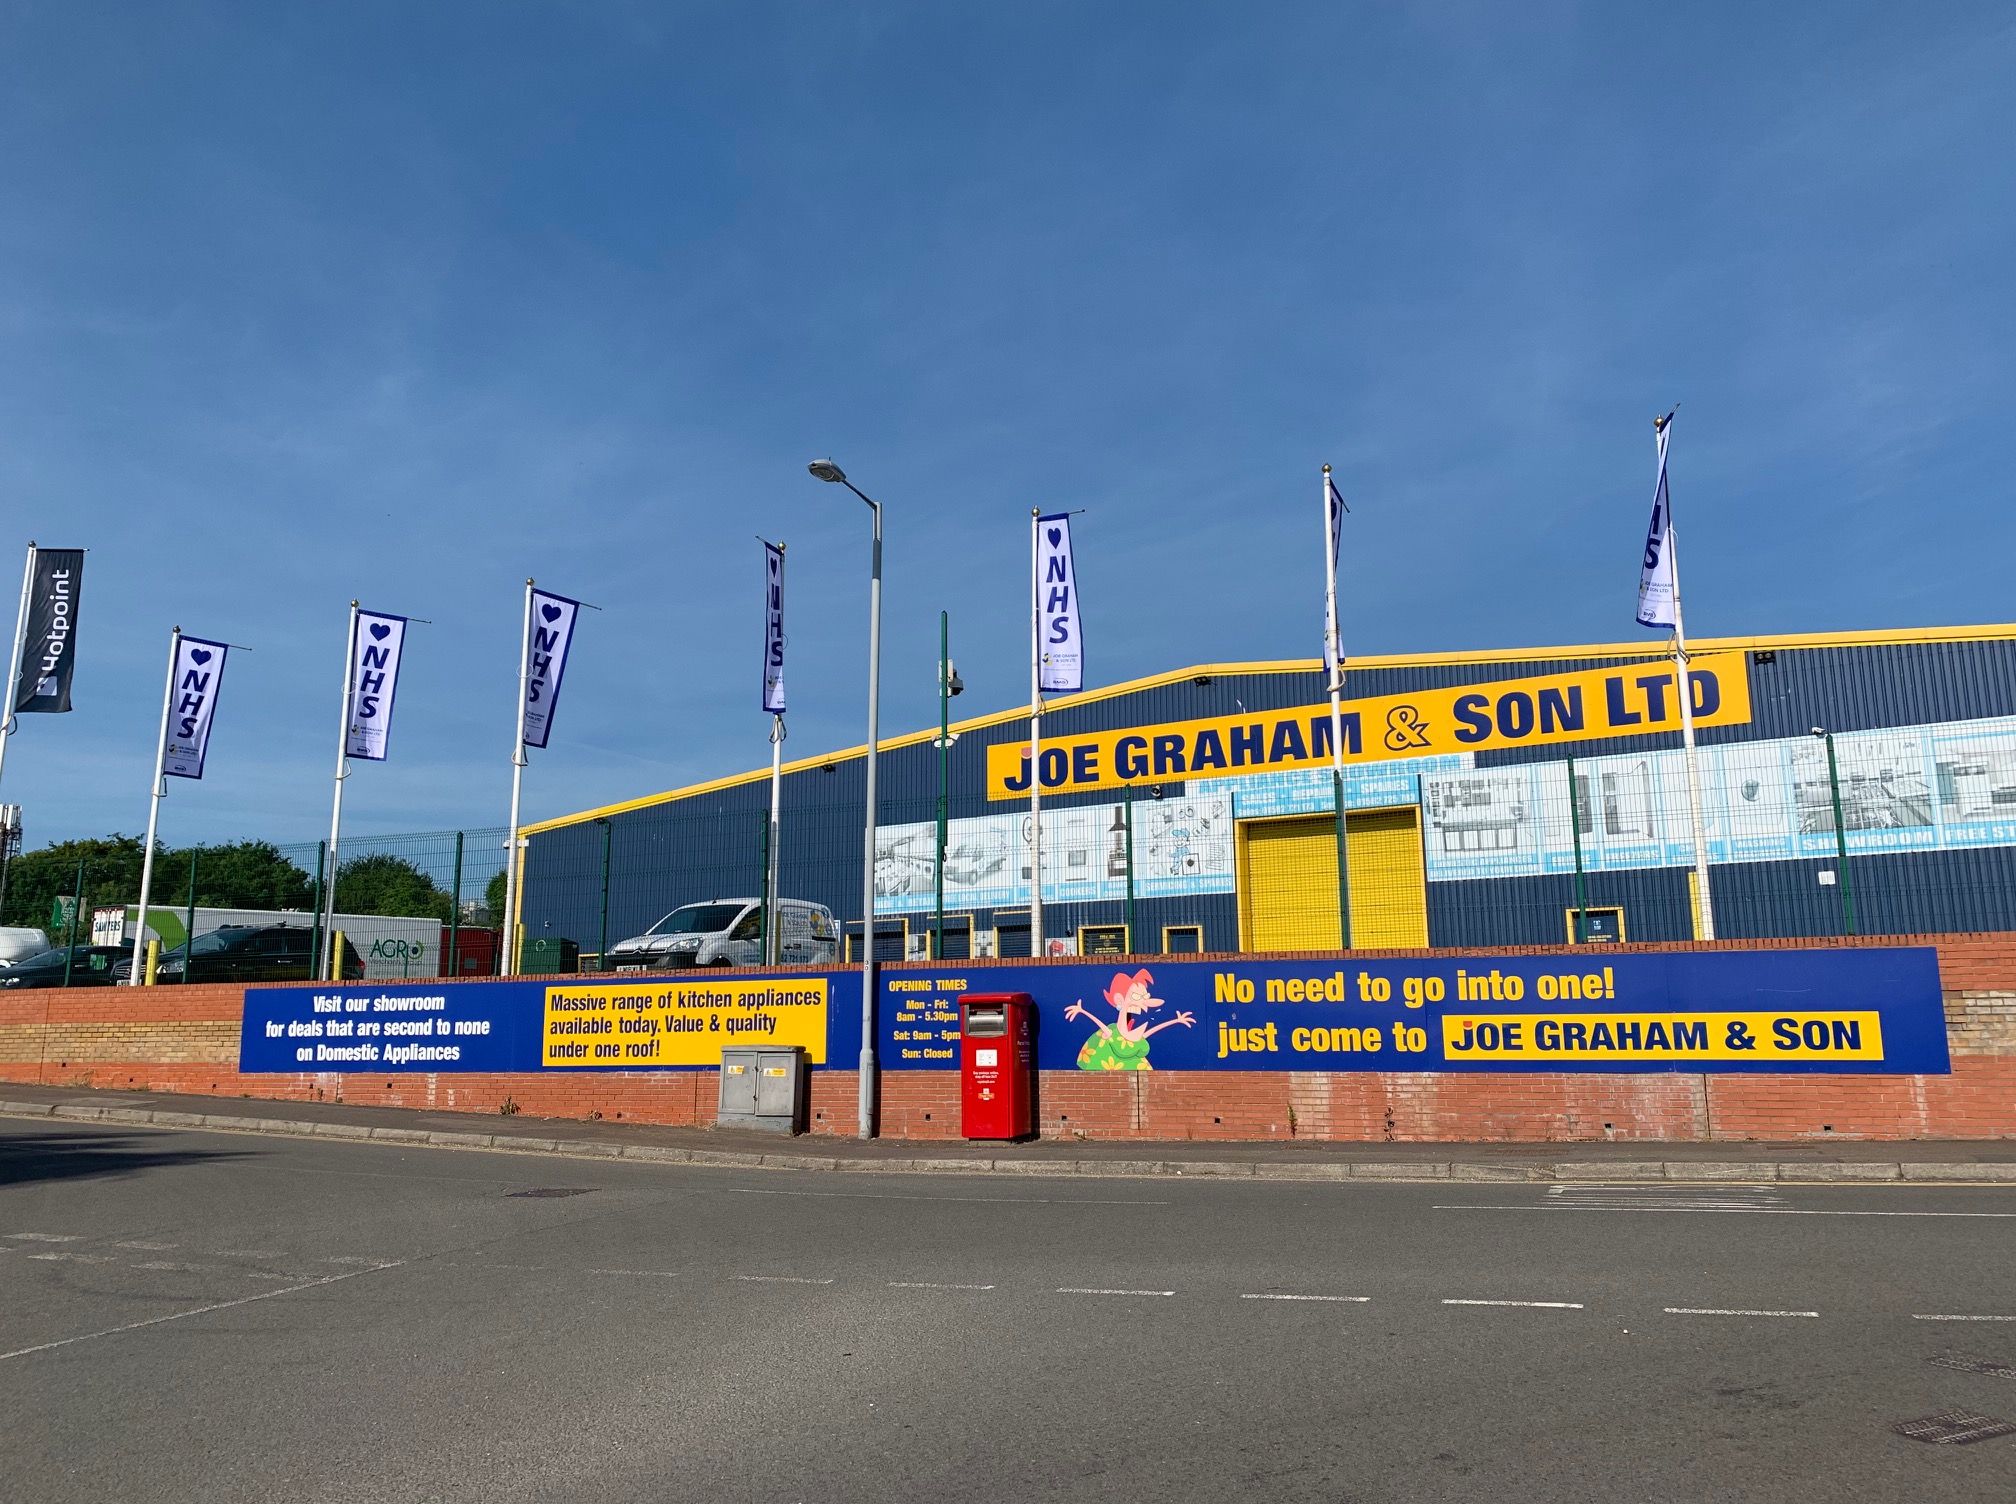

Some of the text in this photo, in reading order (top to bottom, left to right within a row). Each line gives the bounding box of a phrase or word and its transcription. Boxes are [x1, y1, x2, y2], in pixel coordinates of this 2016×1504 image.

[1046, 555, 1069, 644] NHS
[41, 569, 70, 671] Hotpoint
[770, 583, 783, 667] NHS
[528, 625, 560, 703] NHS
[358, 645, 391, 719] NHS
[177, 669, 211, 739] NHS
[1003, 669, 1721, 792] JOE GRAHAM & SON LTD
[1242, 792, 1276, 806] SALES
[1360, 780, 1409, 794] SPARES
[1945, 825, 2016, 842] FREE ST
[1605, 850, 1659, 863] FREEZERS
[1060, 886, 1096, 897] COOKERS
[1146, 880, 1188, 892] SERVICING
[1199, 877, 1232, 888] SPARES
[908, 897, 935, 907] RETAIL
[959, 892, 978, 901] LOCAL
[980, 890, 1010, 901] DELIVERY
[888, 979, 968, 992] OPENING TIMES
[1214, 966, 1615, 1009] No need to go into one!
[313, 994, 445, 1013] Visit our showroom
[550, 989, 821, 1014] Massive range of kitchen appliances
[906, 1000, 925, 1010] Mon
[934, 1000, 949, 1009] Fri:
[550, 1013, 777, 1037] available today. Value & quality
[896, 1012, 915, 1022] 8am
[925, 1011, 958, 1024] 5.30pm
[266, 1018, 490, 1038] for deals that are second to none
[893, 1031, 910, 1041] Sat:
[912, 1031, 932, 1040] 9am
[941, 1030, 961, 1042] 5pm
[1217, 1017, 1862, 1058] just come to JOE GRAHAM & SON
[296, 1043, 460, 1065] on Domestic Appliances
[549, 1039, 660, 1058] under one roof!
[901, 1048, 953, 1059] Sun: Closed
